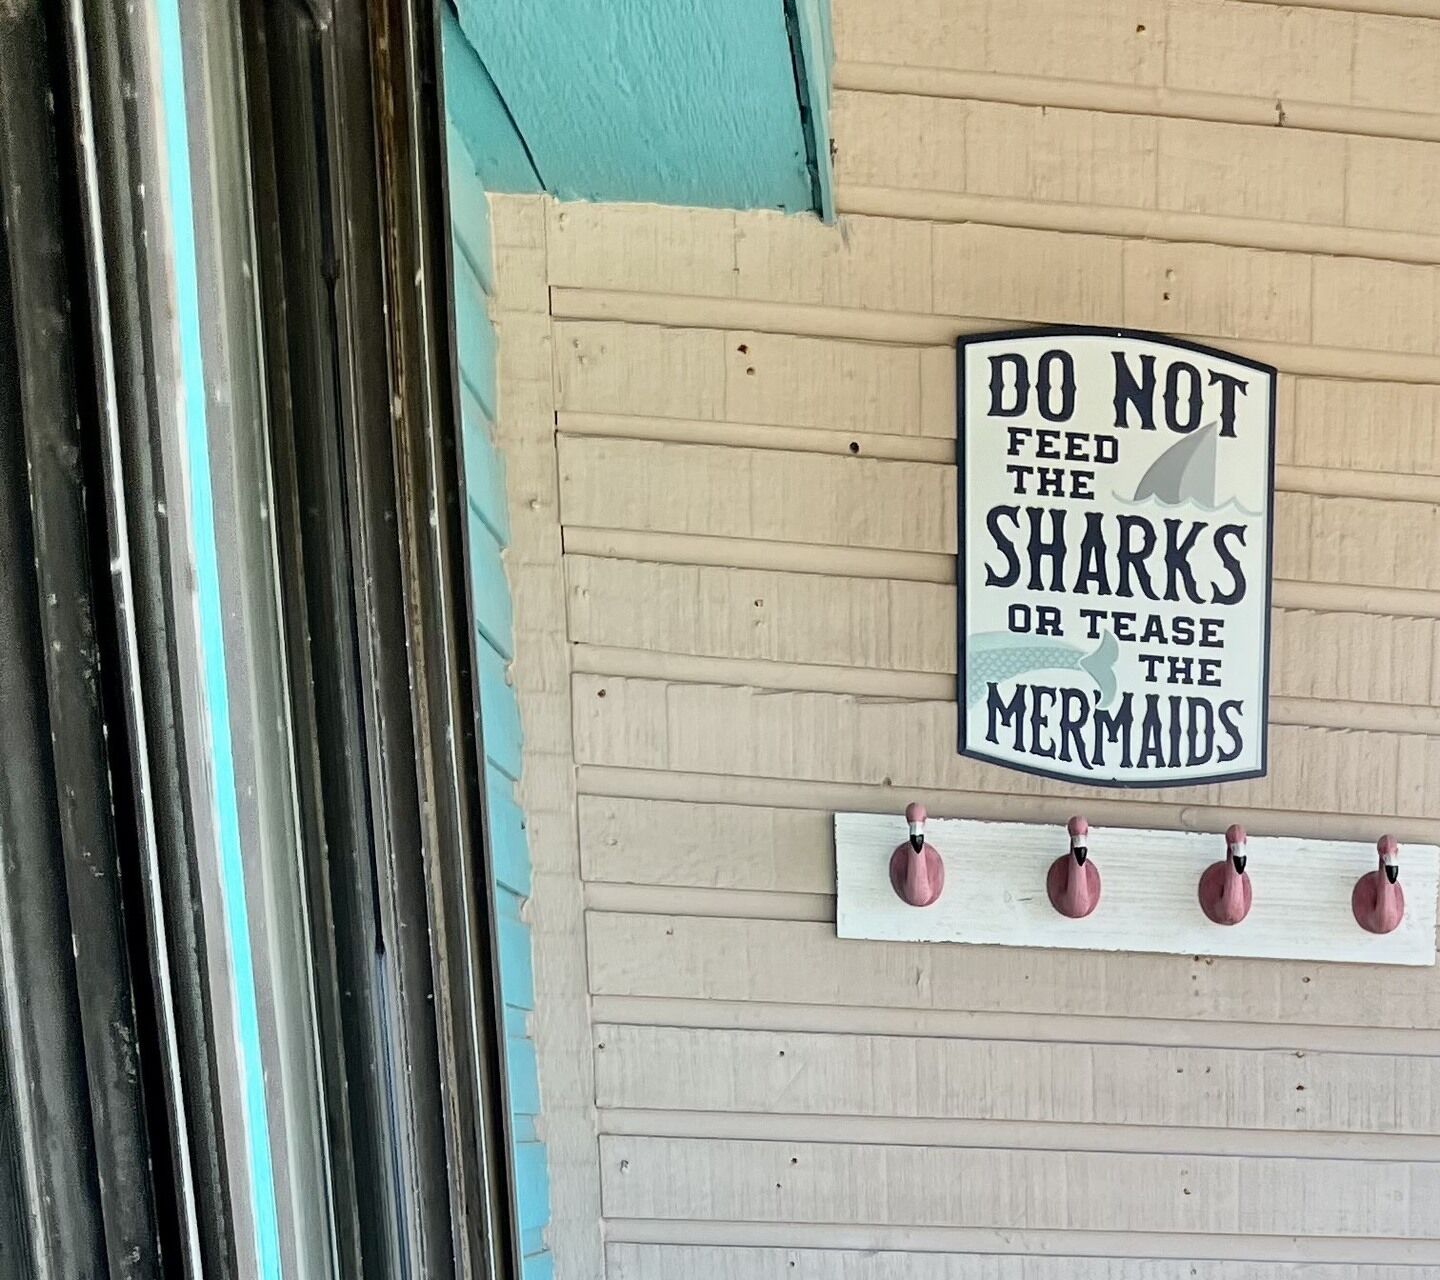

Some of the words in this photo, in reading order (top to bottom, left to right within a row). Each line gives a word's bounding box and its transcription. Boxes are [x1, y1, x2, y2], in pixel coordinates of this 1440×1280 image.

[987, 349, 1077, 422] DO
[1111, 351, 1249, 438] NOT
[1007, 427, 1119, 464] FEED
[1006, 464, 1096, 500] THE
[985, 505, 1248, 605] SHARKS
[1008, 603, 1064, 636] OR
[1079, 608, 1225, 648] TEASE
[1138, 654, 1222, 687] THE
[985, 682, 1244, 770] MERMAIDS
